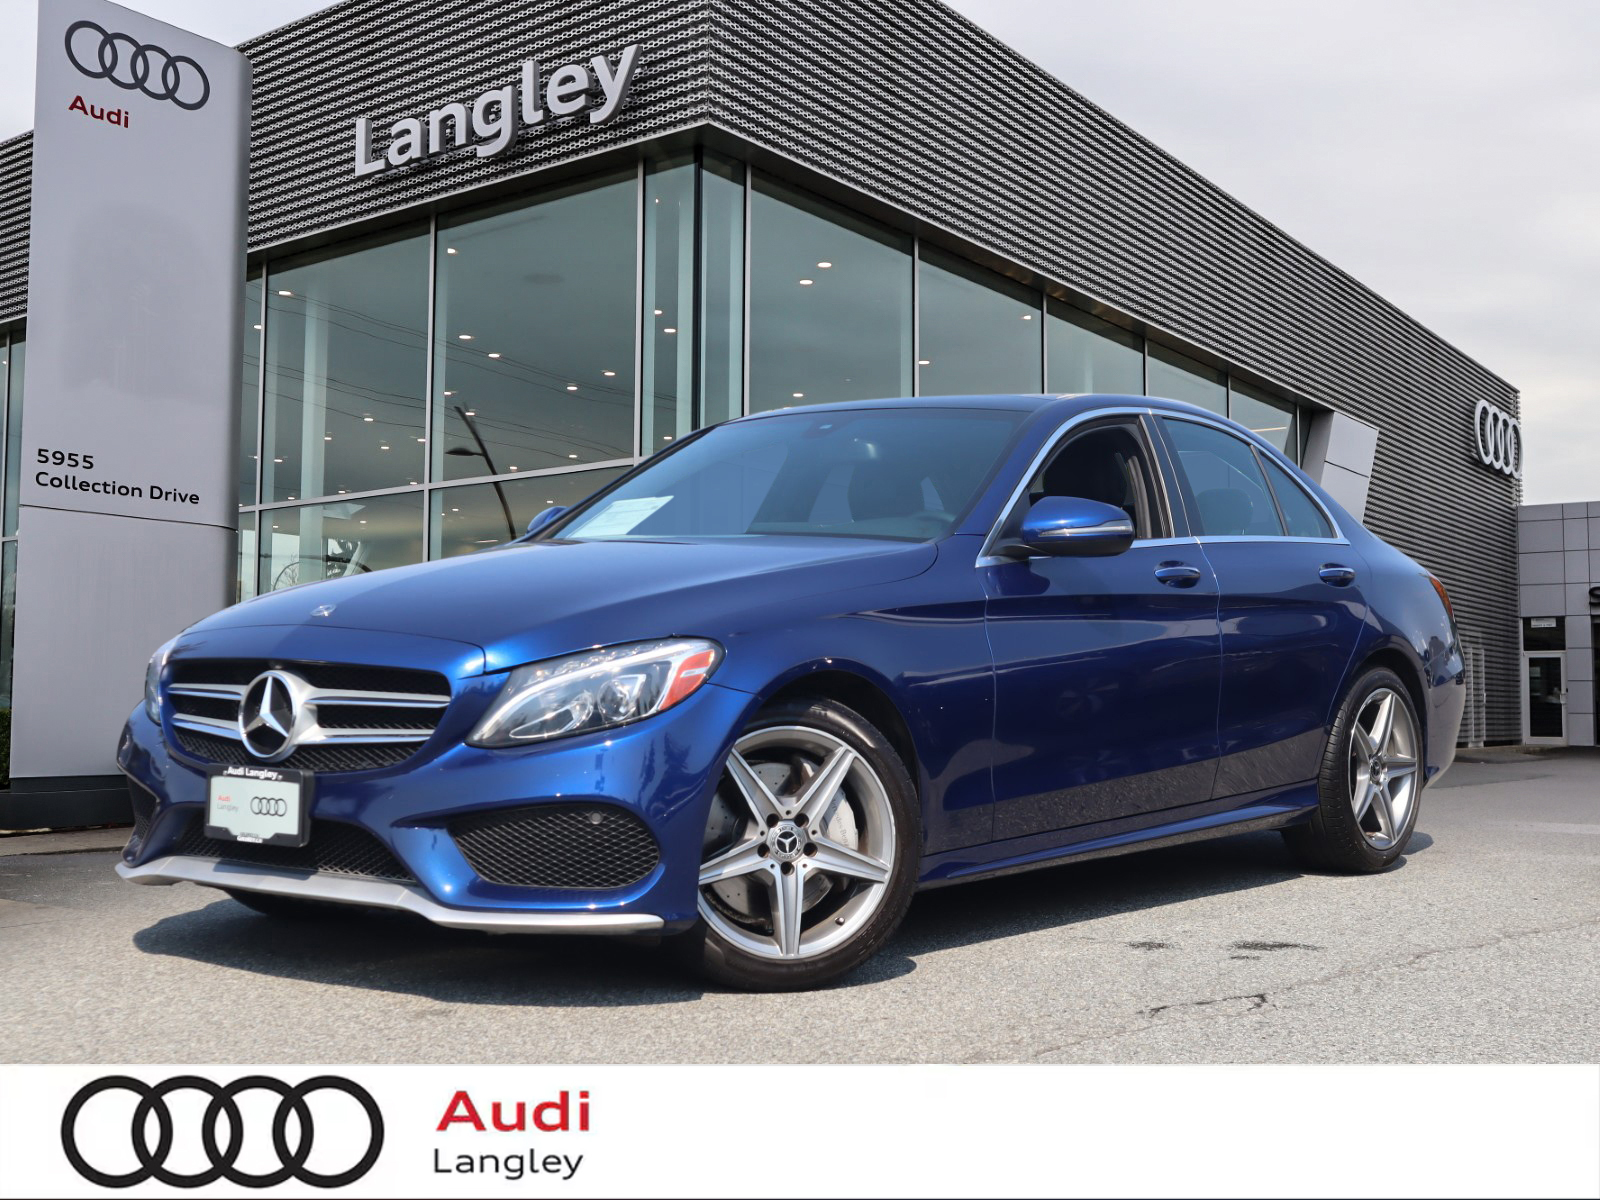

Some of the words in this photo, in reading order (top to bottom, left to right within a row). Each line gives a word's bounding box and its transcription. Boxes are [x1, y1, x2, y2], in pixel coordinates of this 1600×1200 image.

[69, 95, 129, 128] Audi
[354, 44, 642, 177] Langley
[37, 448, 94, 470] 5955
[35, 471, 143, 498] Collection
[150, 485, 200, 504] Drive
[228, 766, 245, 776] Audi
[245, 767, 278, 780] Langley
